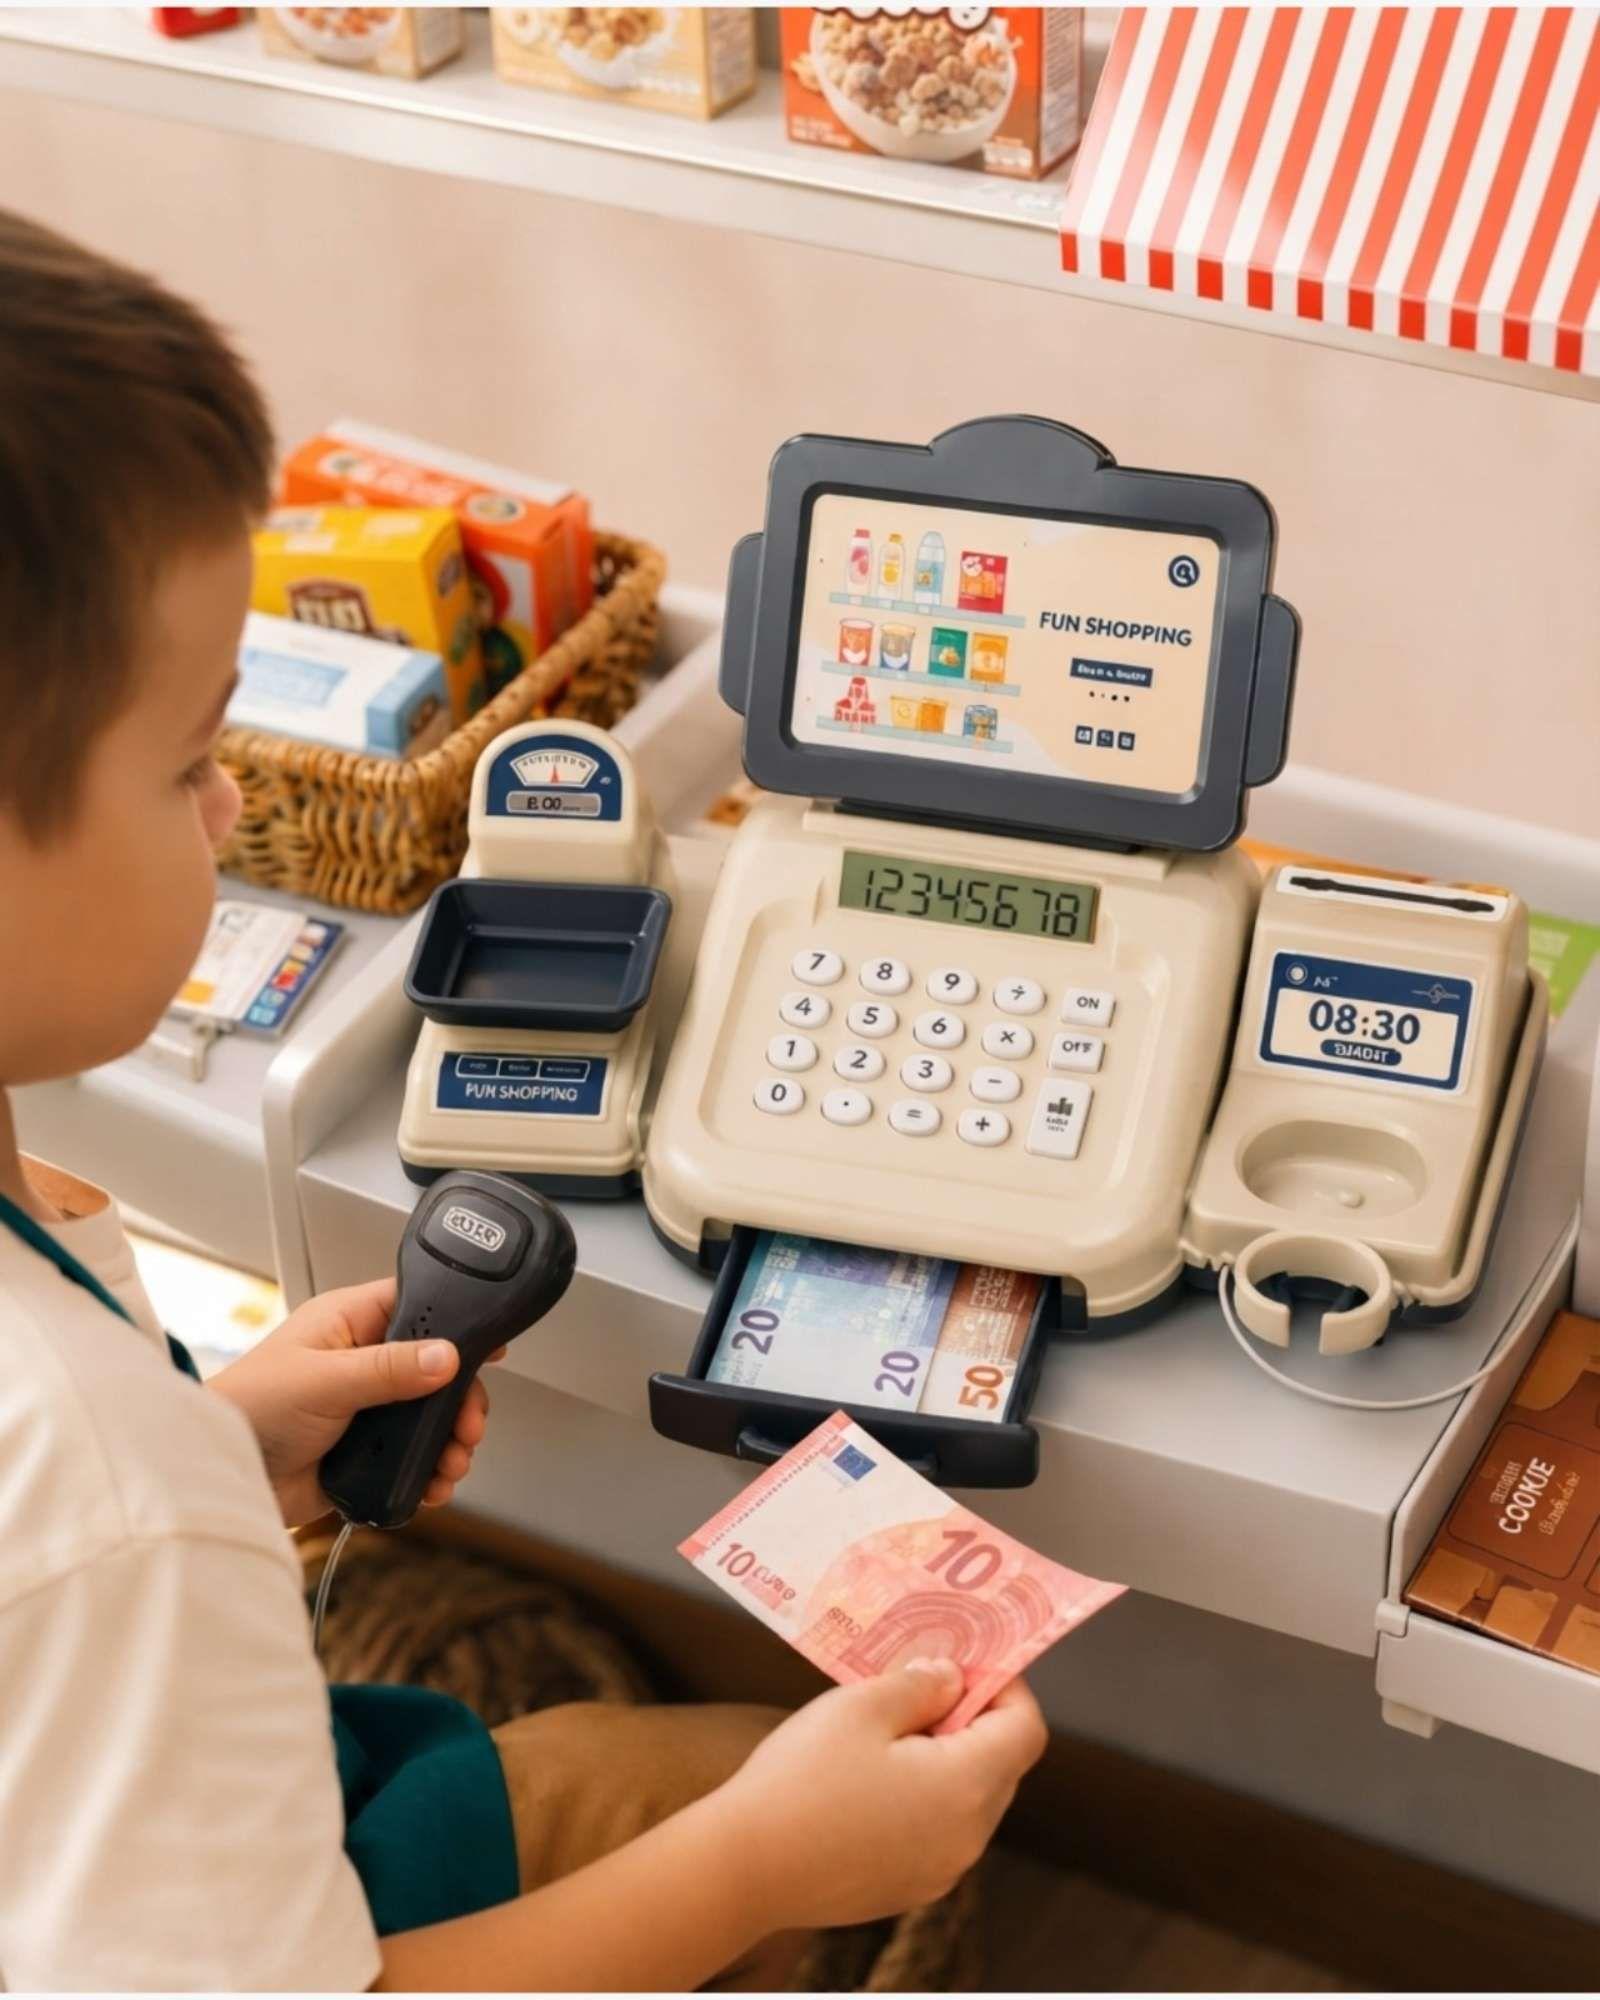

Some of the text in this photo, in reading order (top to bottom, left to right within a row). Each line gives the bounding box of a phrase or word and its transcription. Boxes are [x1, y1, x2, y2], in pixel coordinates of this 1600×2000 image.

[1040, 611, 1192, 647] FUN SHOPPING
[863, 869, 1081, 938] 12345678
[809, 953, 826, 971] 7
[875, 963, 893, 981] 8
[943, 973, 961, 991] 9
[794, 999, 812, 1016] 4
[1076, 997, 1100, 1009] ON
[862, 1007, 880, 1025] 5
[1309, 1000, 1420, 1045] 08:30
[931, 1017, 948, 1035] 6
[785, 1041, 796, 1058] 1
[849, 1051, 868, 1069] 2
[917, 1061, 934, 1079] 3
[771, 1084, 787, 1102] 0
[731, 1308, 780, 1355] 20
[874, 1351, 920, 1396] 20
[958, 1365, 1005, 1410] 50
[716, 1543, 756, 1577] 10
[924, 1530, 1003, 1591] 10
